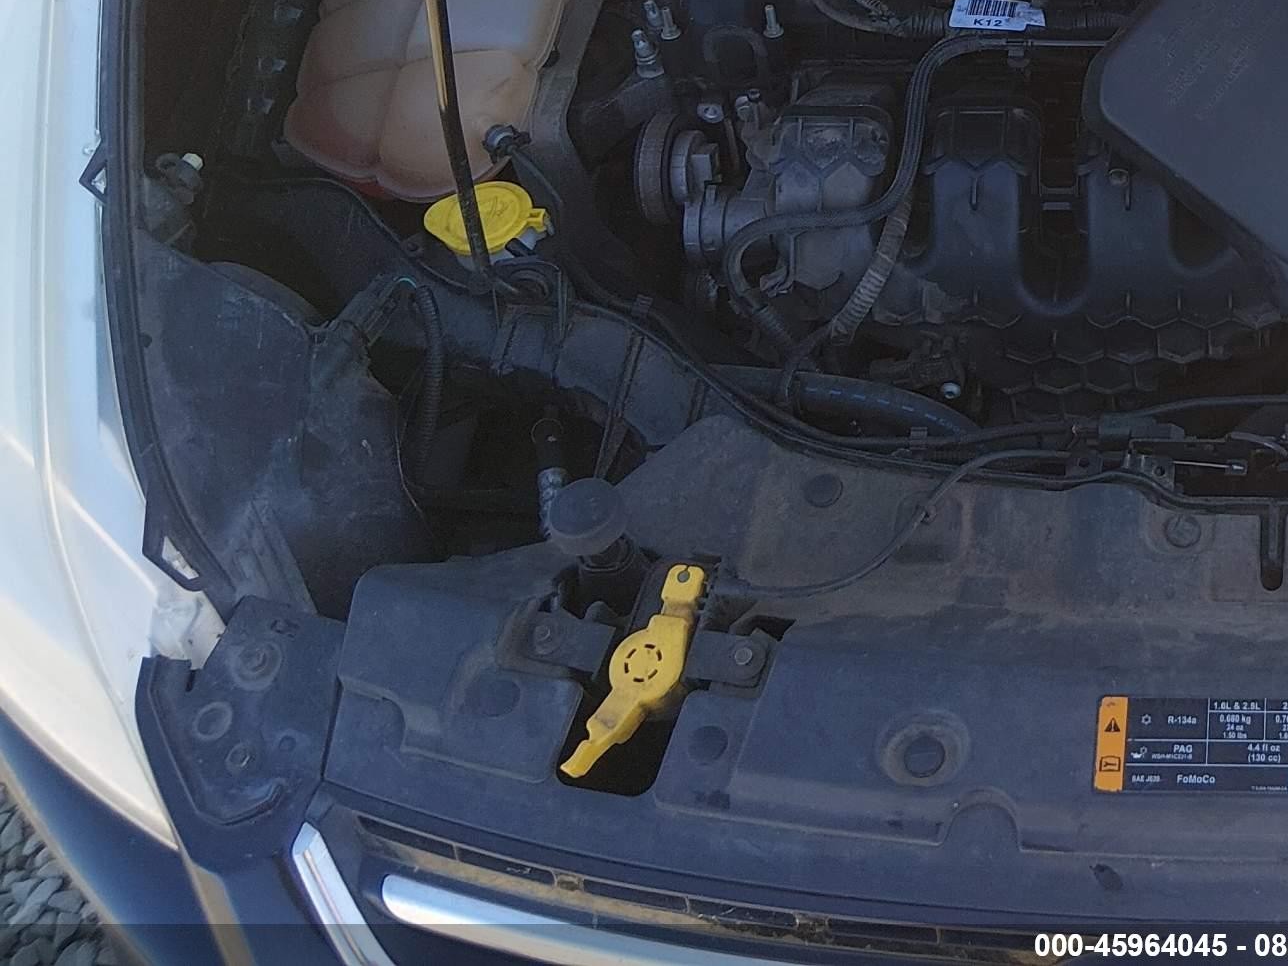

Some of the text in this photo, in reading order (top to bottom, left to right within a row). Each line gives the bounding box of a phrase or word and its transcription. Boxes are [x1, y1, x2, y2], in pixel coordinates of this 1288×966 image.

[973, 18, 1003, 27] K12
[1233, 701, 1241, 710] &
[1167, 715, 1197, 725] R-134a
[1241, 714, 1252, 725] kg
[1173, 744, 1193, 753] PAG
[1247, 743, 1280, 752] 4.4 fl oz
[1247, 753, 1281, 763] (130 cc)
[1176, 774, 1216, 784] FoMoCo
